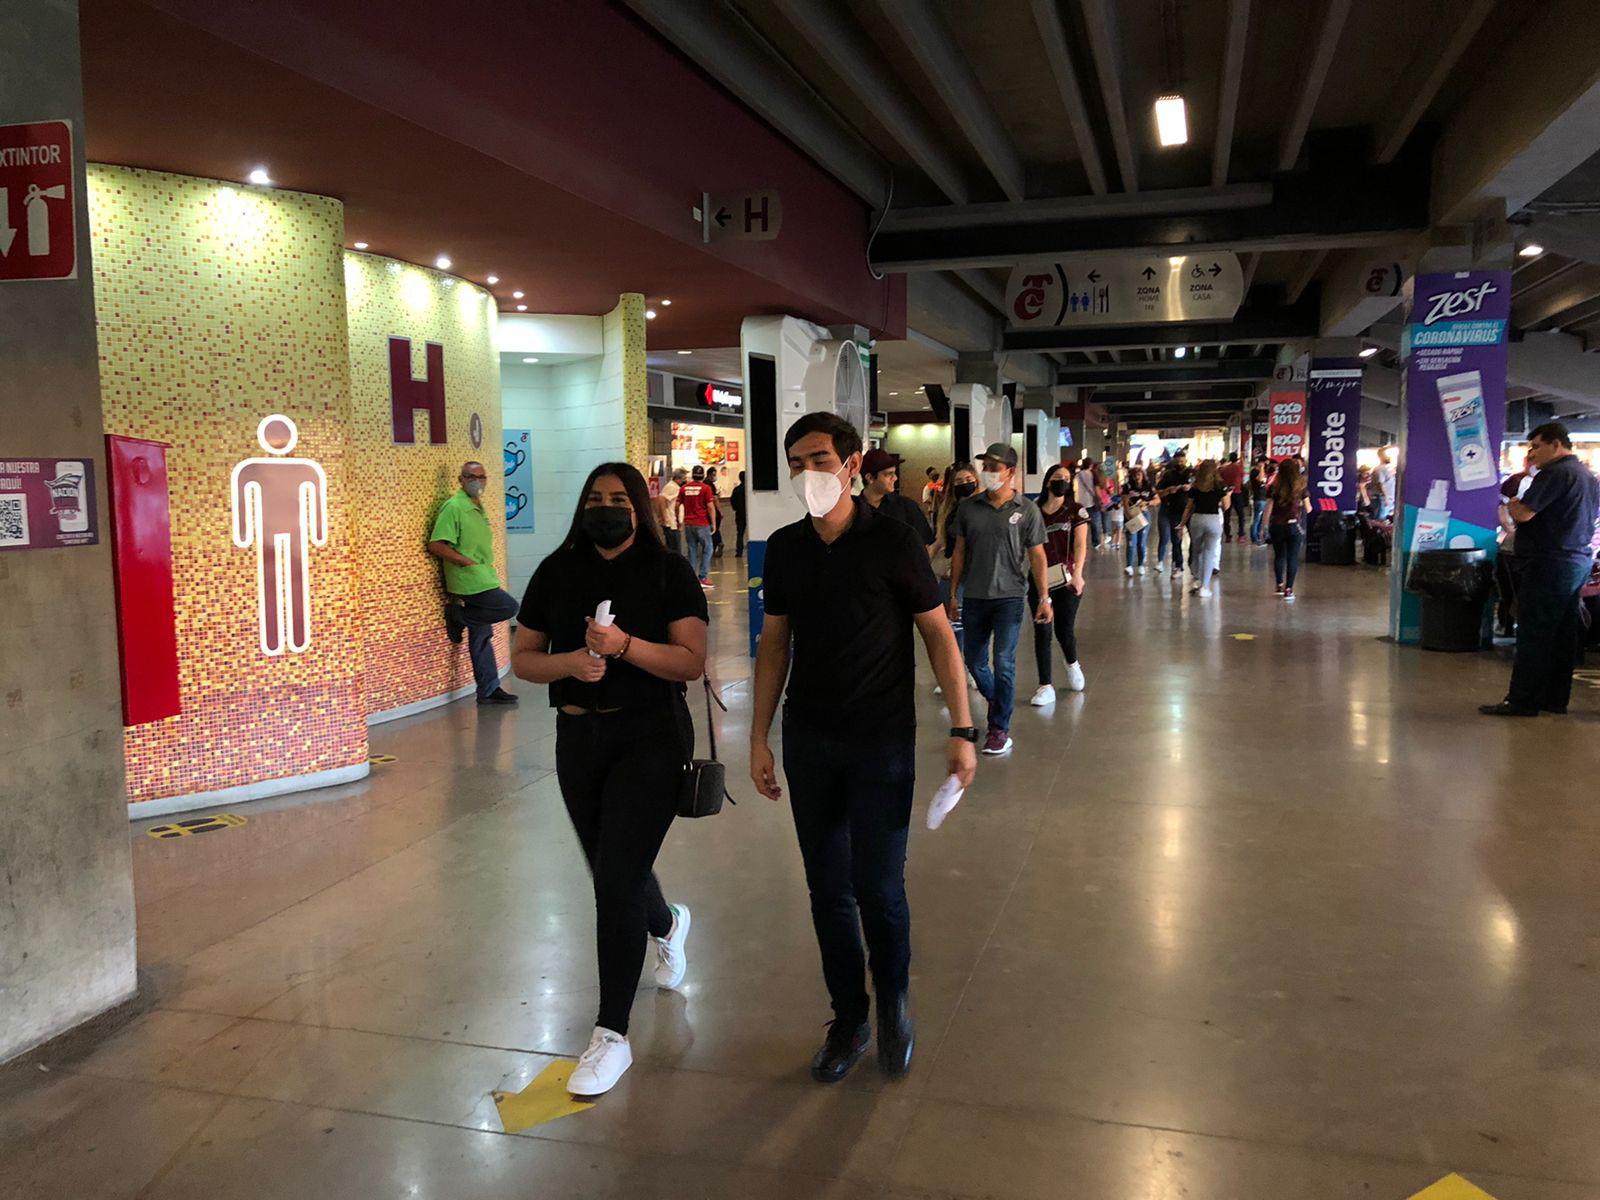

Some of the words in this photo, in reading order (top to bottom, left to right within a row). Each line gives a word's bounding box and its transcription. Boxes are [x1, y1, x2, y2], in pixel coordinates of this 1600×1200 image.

[744, 197, 769, 232] H
[1137, 286, 1160, 294] ZONA
[1190, 284, 1213, 292] ZONA
[1414, 329, 1499, 345] CORONAVIRUS
[387, 335, 448, 446] H
[1272, 414, 1302, 425] 101.7
[1272, 446, 1300, 456] 101.7
[1317, 412, 1346, 497] debate
[6, 462, 40, 473] NUESTRA
